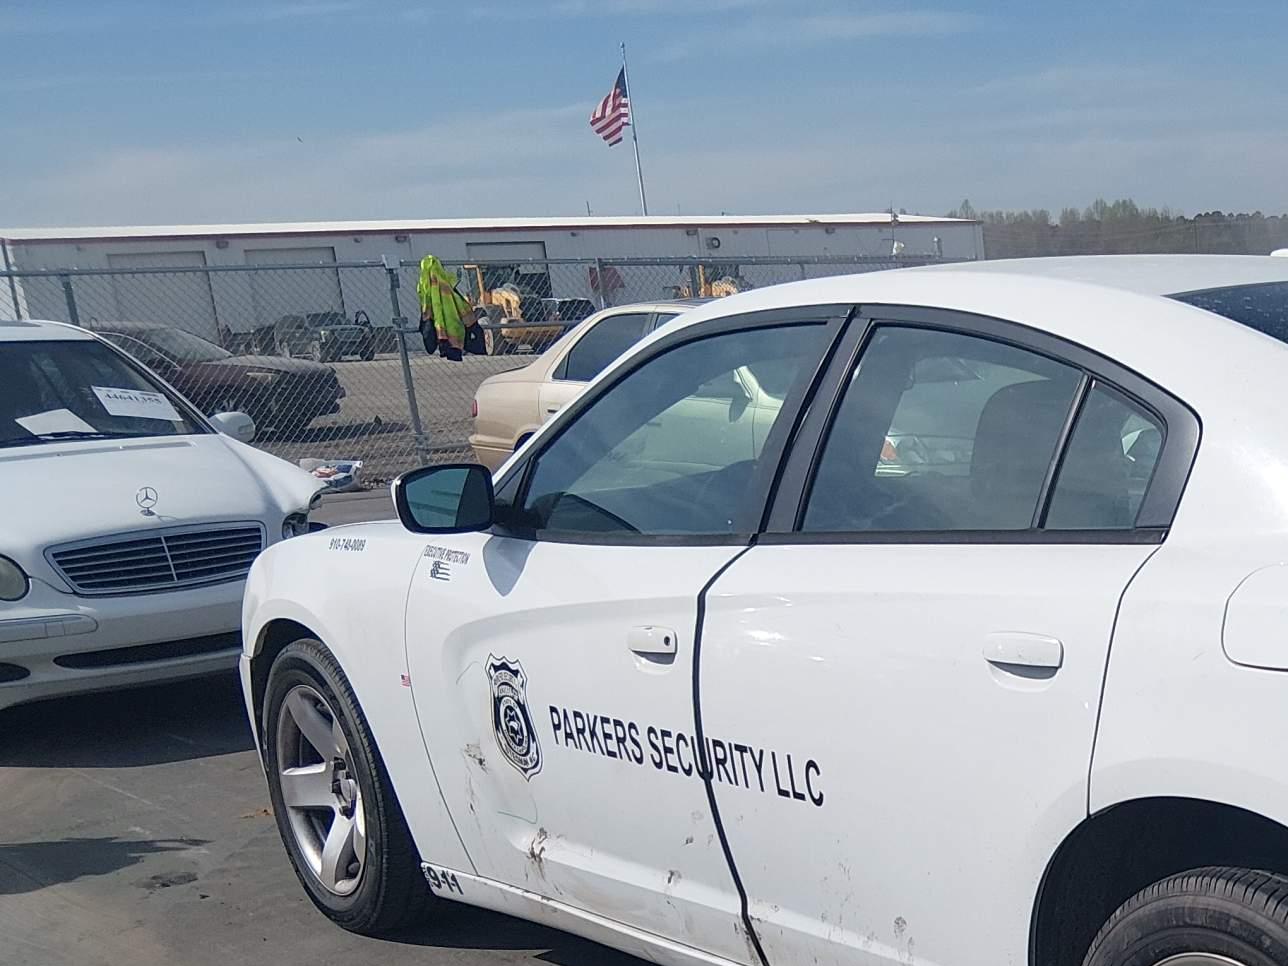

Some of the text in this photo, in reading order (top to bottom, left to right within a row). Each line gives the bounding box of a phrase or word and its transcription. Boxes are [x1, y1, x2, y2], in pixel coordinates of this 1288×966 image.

[548, 705, 645, 765] PARKERS
[646, 727, 765, 792] SECURITY
[769, 750, 825, 807] LLC
